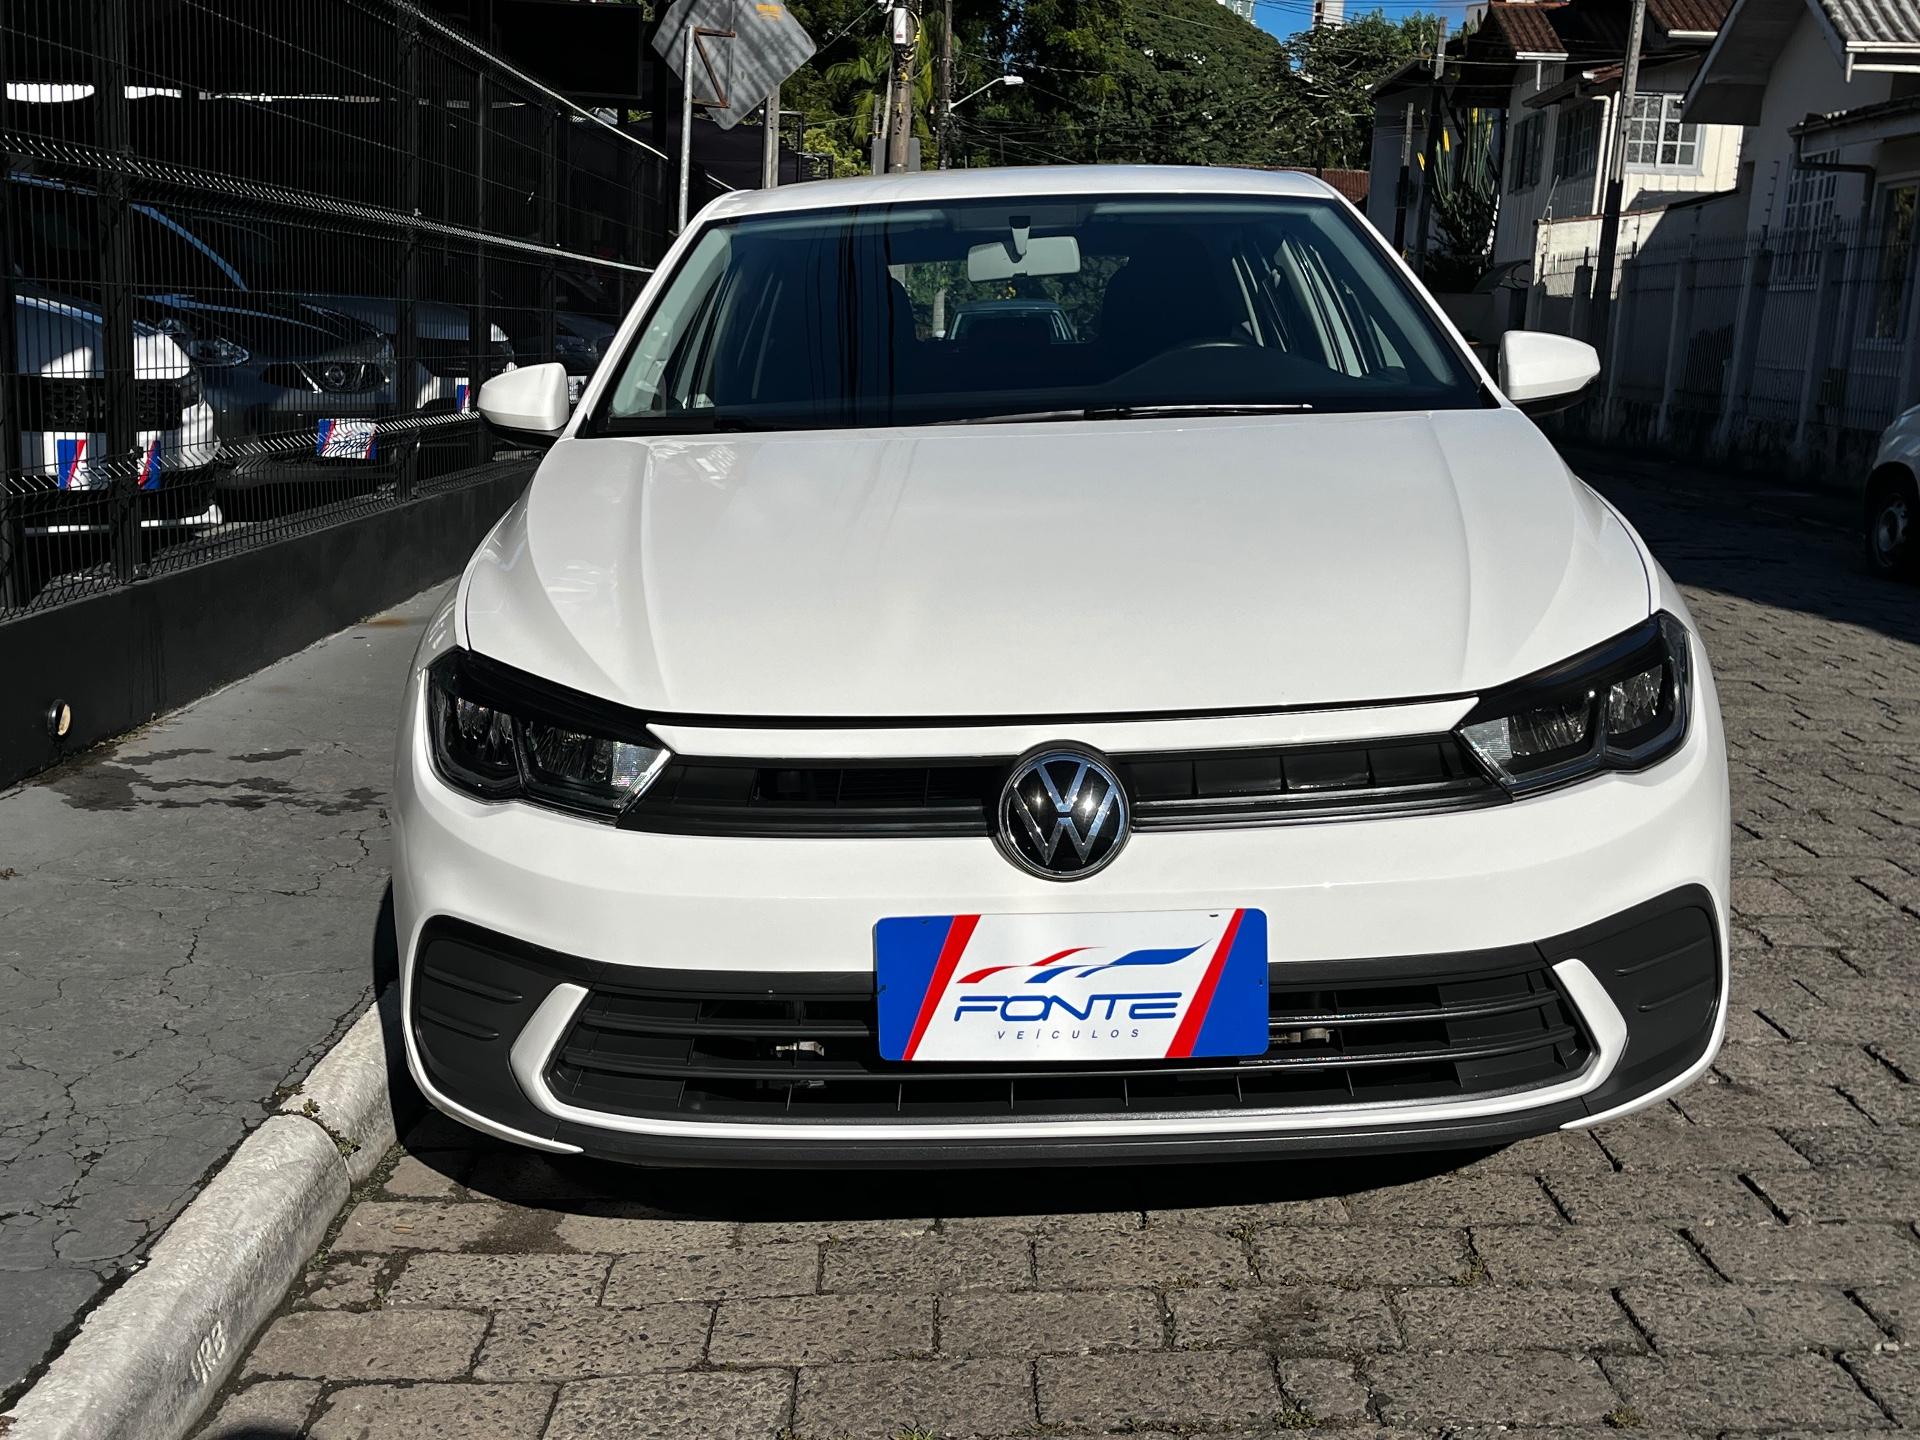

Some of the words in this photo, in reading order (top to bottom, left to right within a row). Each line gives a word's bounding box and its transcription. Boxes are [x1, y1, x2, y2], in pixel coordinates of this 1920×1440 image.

[1007, 757, 1120, 868] VW
[953, 991, 1183, 1022] FONTE
[997, 1027, 1140, 1040] VEÍCULOS
